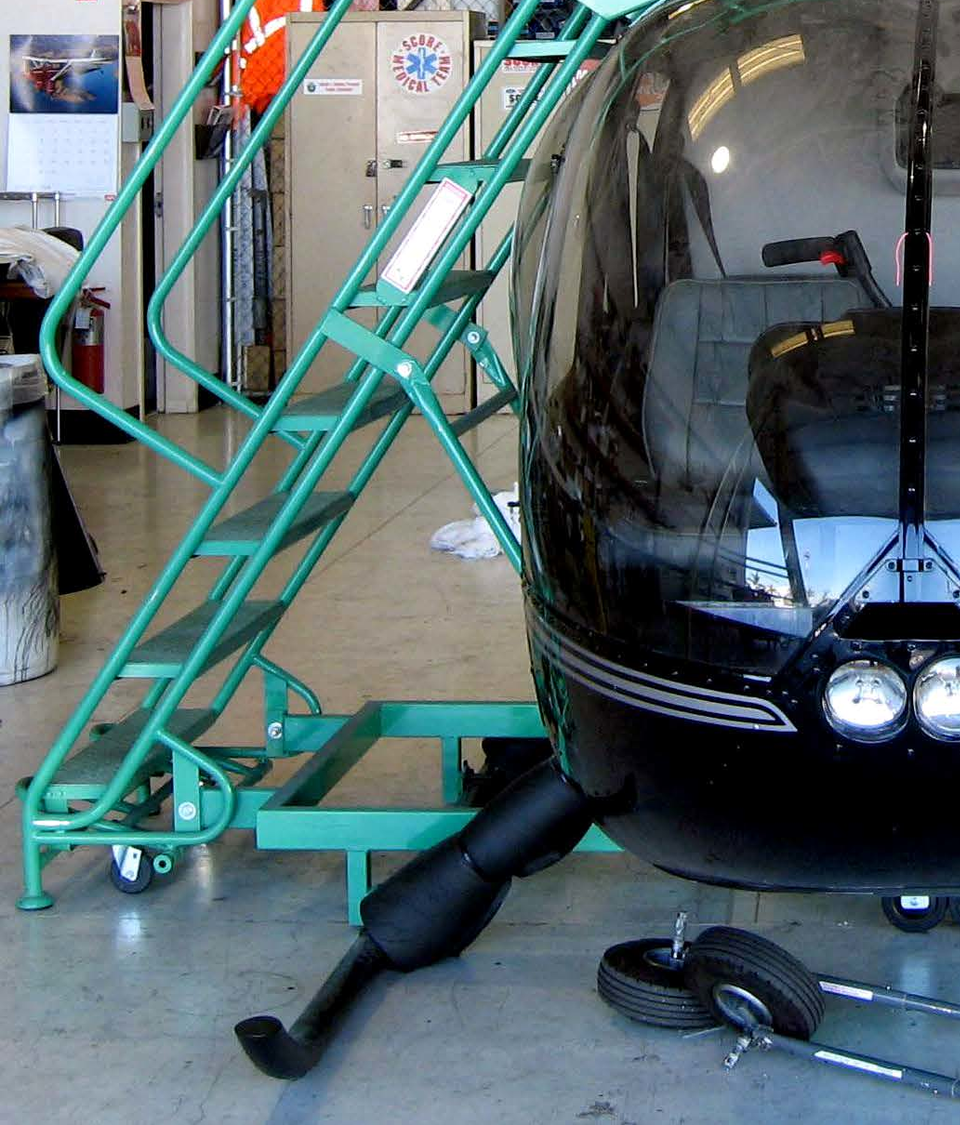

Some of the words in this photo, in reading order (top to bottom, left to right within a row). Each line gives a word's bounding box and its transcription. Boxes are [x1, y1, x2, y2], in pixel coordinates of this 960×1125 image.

[402, 34, 443, 51] SCORE
[392, 55, 430, 93] MEDICAL
[431, 56, 451, 86] TEAM
